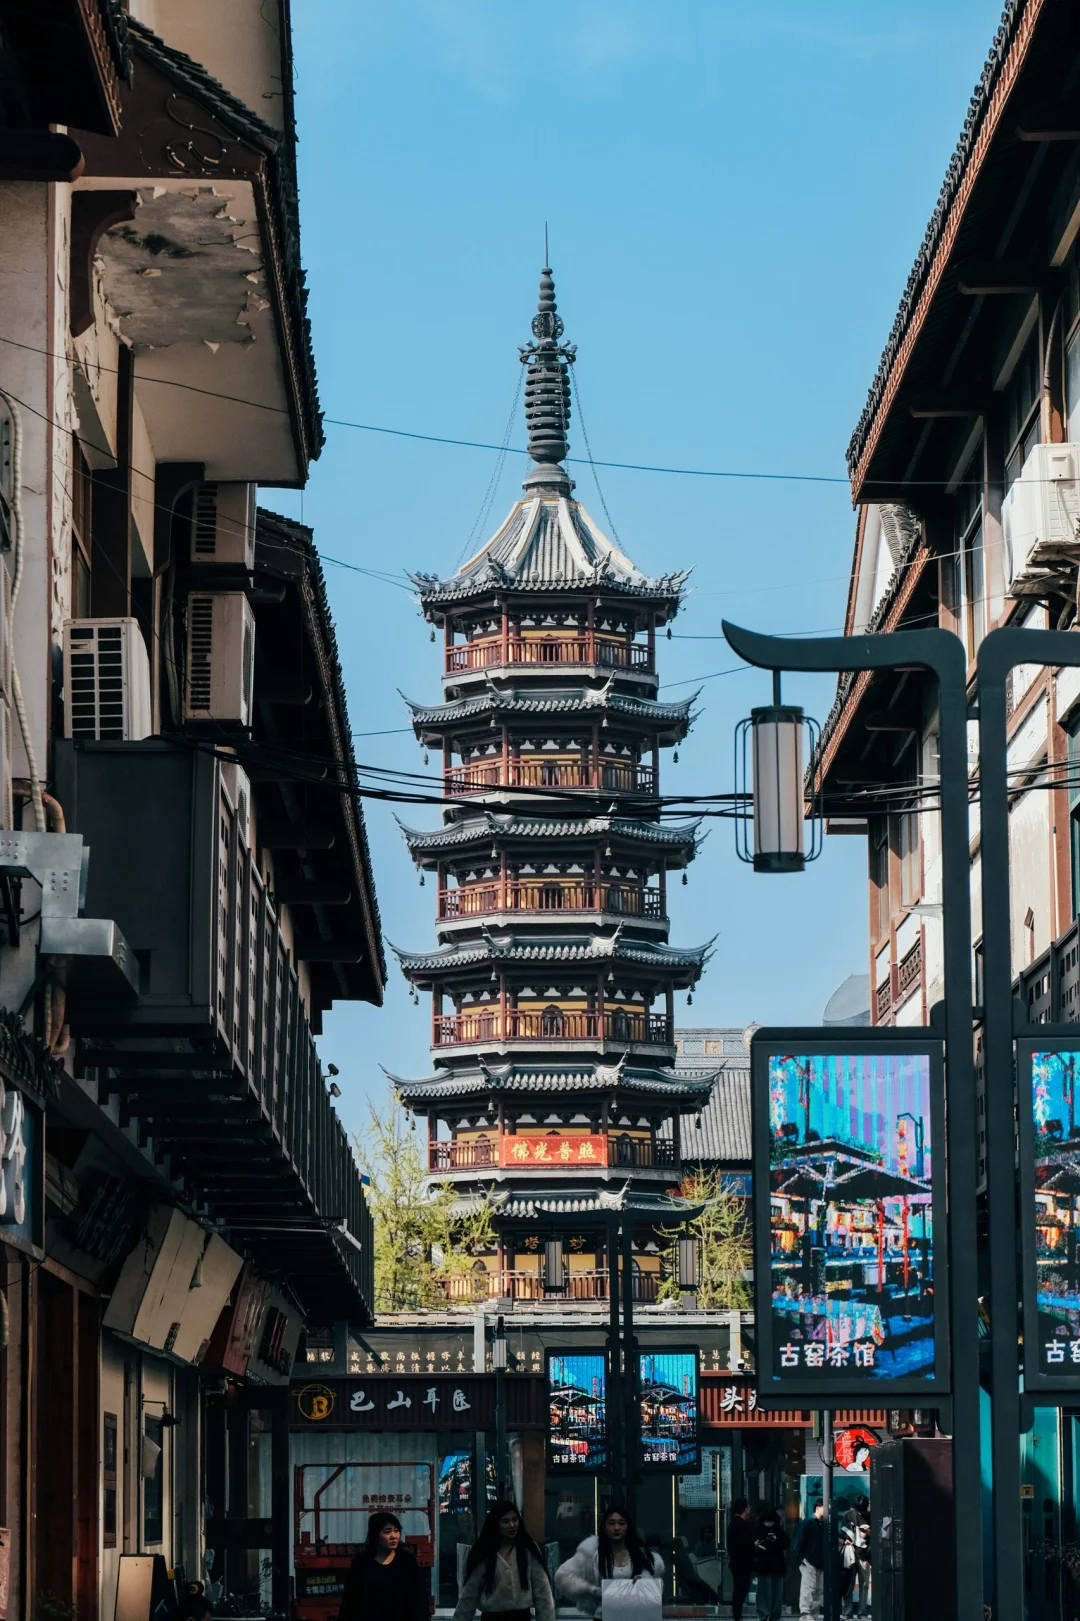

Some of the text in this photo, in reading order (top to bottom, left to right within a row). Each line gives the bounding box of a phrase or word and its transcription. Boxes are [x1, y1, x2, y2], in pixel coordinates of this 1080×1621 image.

[510, 1140, 597, 1161] 佛光普照
[779, 1342, 875, 1367] 古窑茶馆
[350, 1387, 471, 1414] 巴山耳匠
